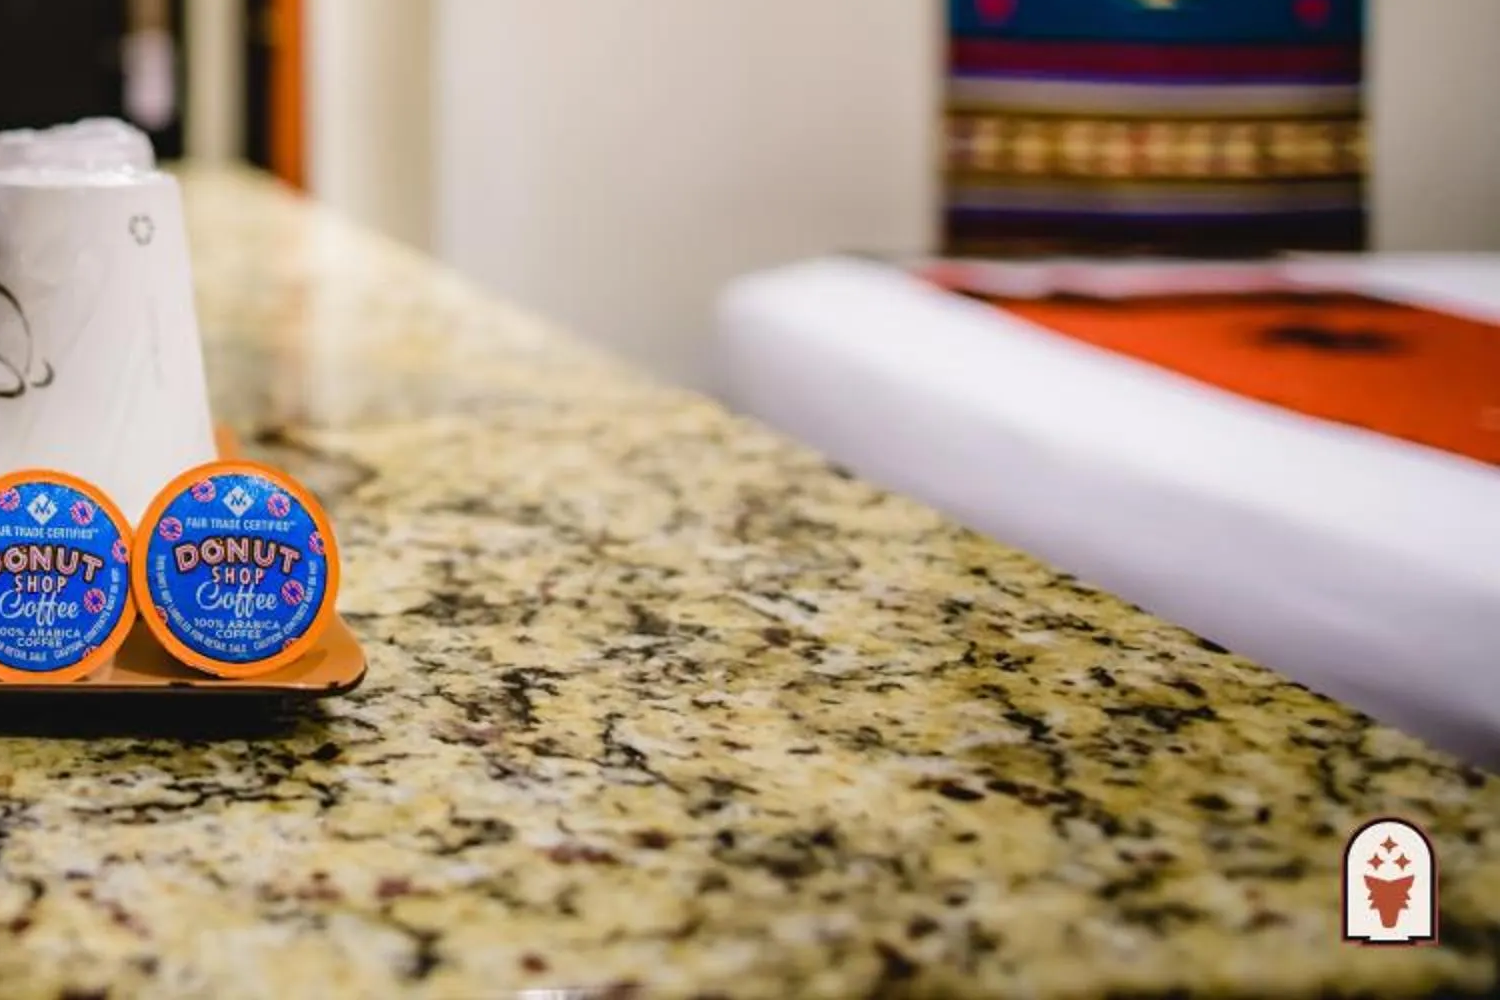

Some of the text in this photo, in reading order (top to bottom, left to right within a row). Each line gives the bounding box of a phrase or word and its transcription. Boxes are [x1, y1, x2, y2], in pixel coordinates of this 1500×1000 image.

[173, 536, 301, 574] DONUT
[15, 574, 68, 593] SHOP
[212, 566, 265, 585] SHOP
[196, 581, 278, 618] Coffee
[193, 617, 281, 630] 100% ARABICA
[30, 627, 81, 639] ARABICA
[215, 629, 262, 639] COFFEE
[17, 637, 63, 648] COFFEE
